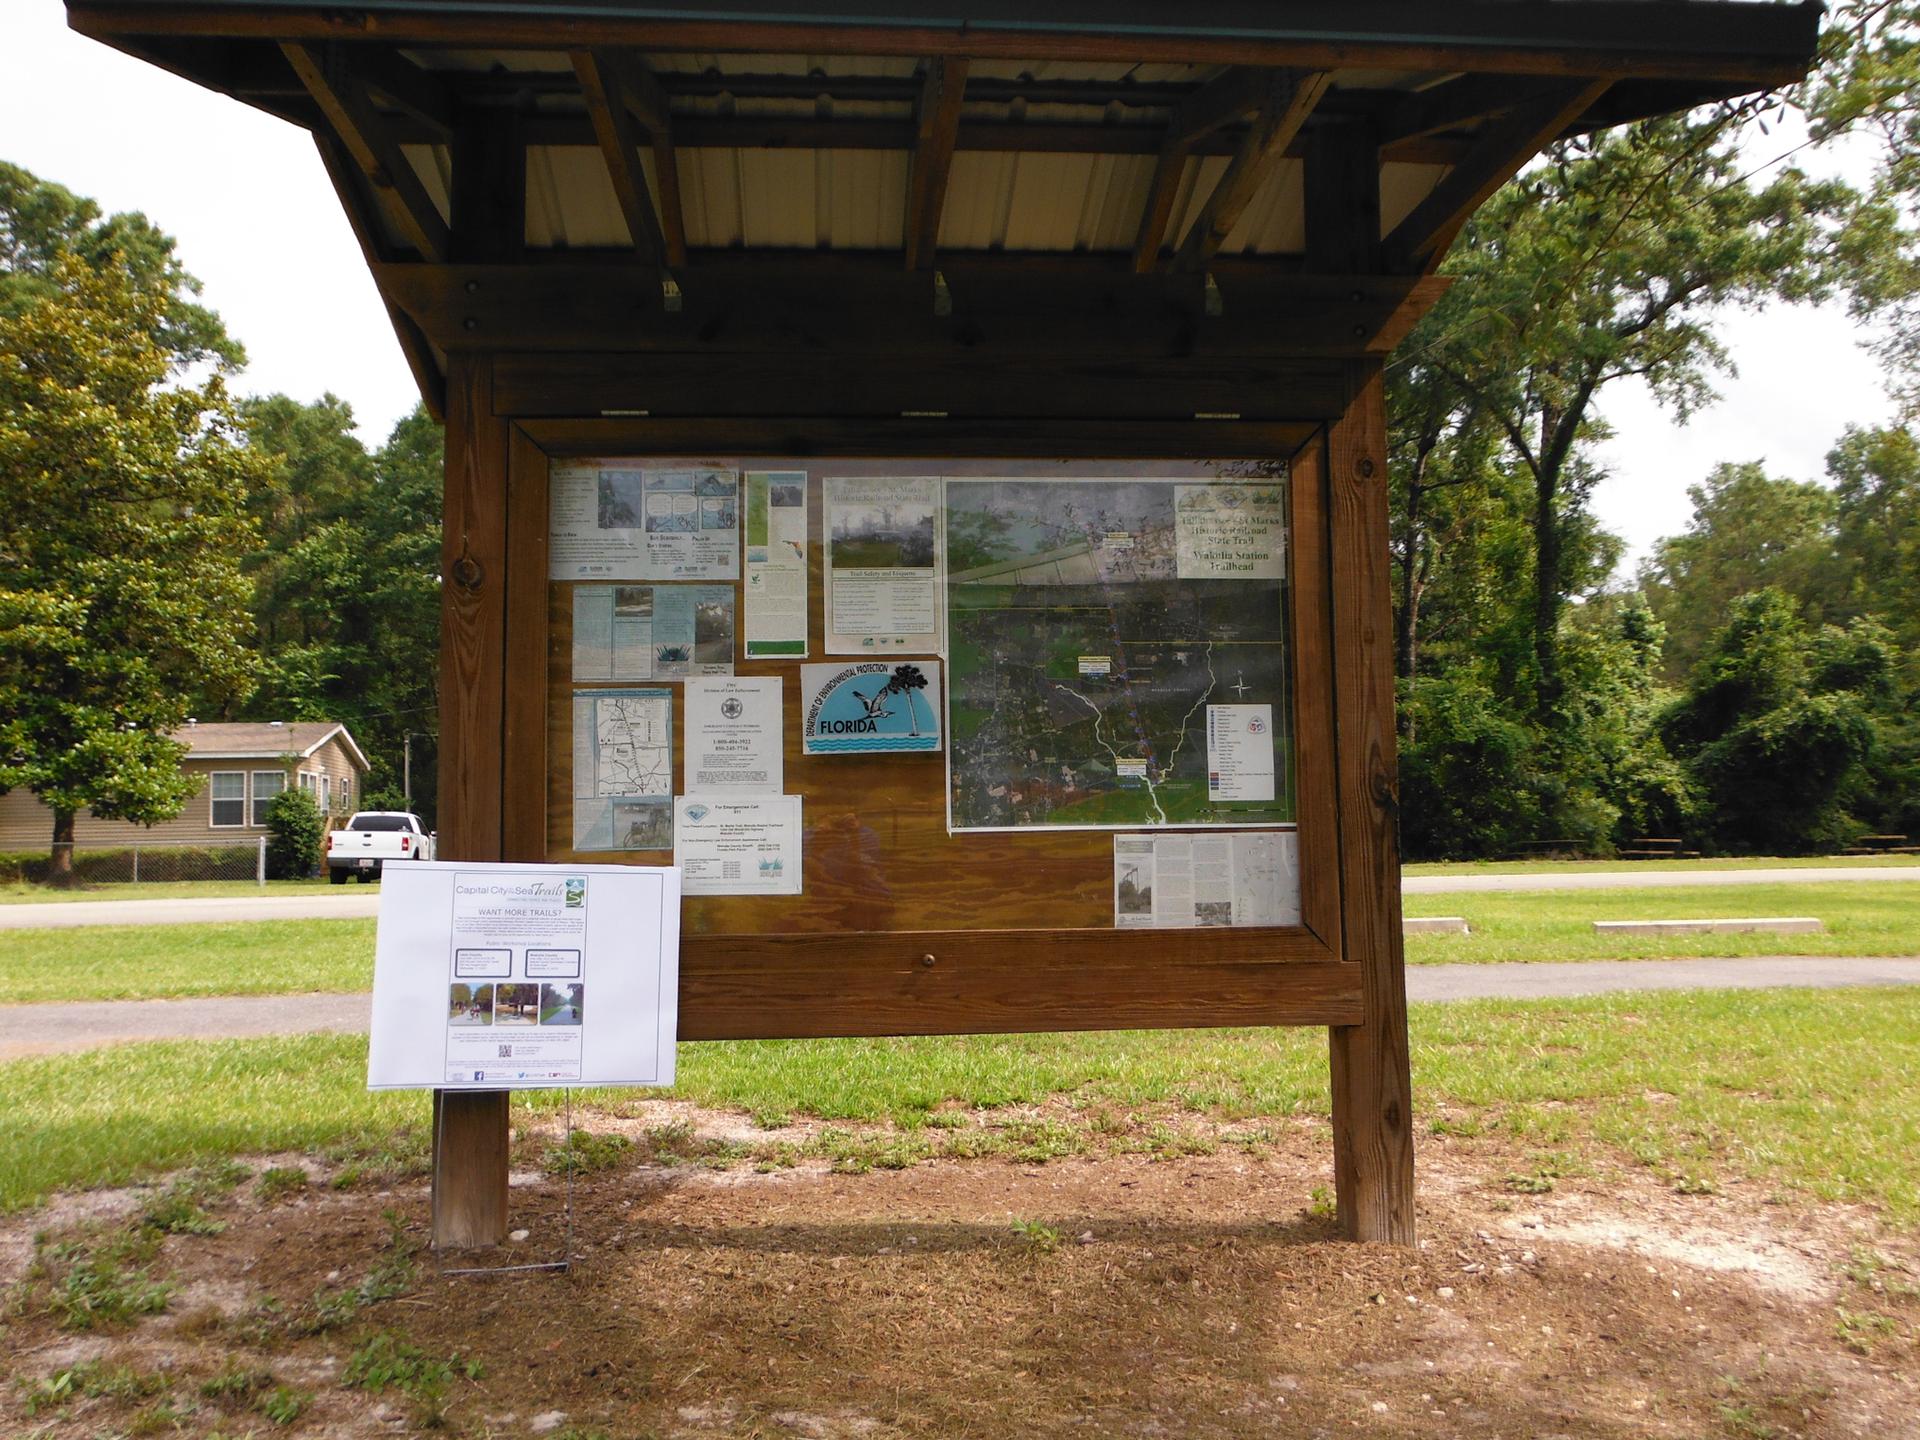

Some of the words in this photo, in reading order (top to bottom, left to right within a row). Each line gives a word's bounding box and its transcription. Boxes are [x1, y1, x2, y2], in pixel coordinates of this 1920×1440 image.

[1192, 526, 1227, 535] Historic
[1229, 526, 1268, 535] Railroad
[1208, 536, 1230, 545] State
[1232, 536, 1254, 545] Trail
[1193, 552, 1233, 560] Wakulla
[1236, 552, 1269, 560] Station
[1210, 562, 1254, 571] Trailhead
[806, 703, 820, 736] DEPARTMENT
[820, 670, 857, 699] ENVIRONMENTAL
[856, 664, 888, 675] PROTECTION
[820, 720, 877, 734] FLORIDA
[456, 886, 489, 895] Capital
[490, 886, 508, 896] City
[515, 886, 532, 896] Sea
[531, 882, 564, 896] Trails
[478, 908, 502, 916] WANT
[504, 908, 527, 916] MORE
[530, 908, 562, 917] TRAILS?
